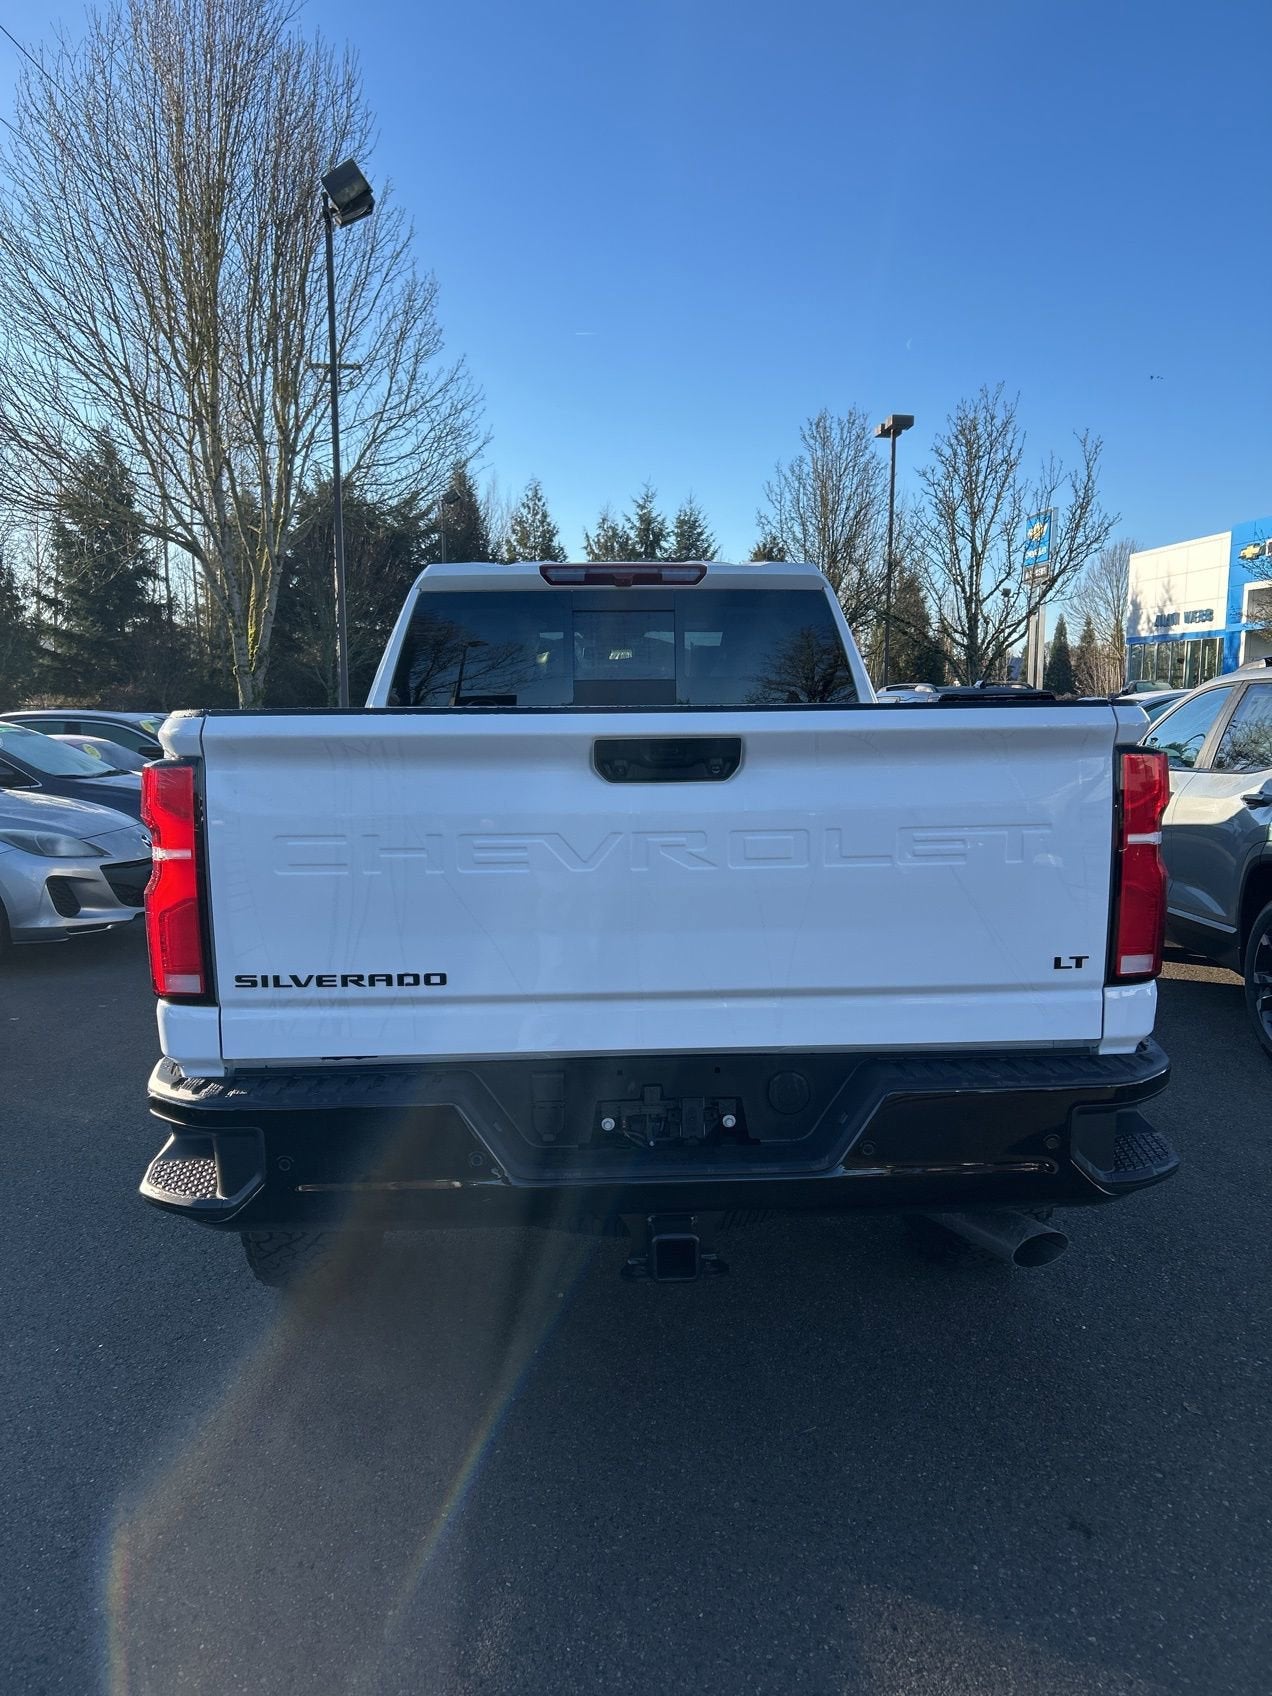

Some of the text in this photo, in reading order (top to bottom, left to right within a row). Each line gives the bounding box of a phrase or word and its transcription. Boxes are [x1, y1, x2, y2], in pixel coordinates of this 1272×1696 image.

[273, 823, 1052, 876] CHEVROLET
[1054, 955, 1089, 970] LT
[234, 972, 448, 988] SILVERADO
